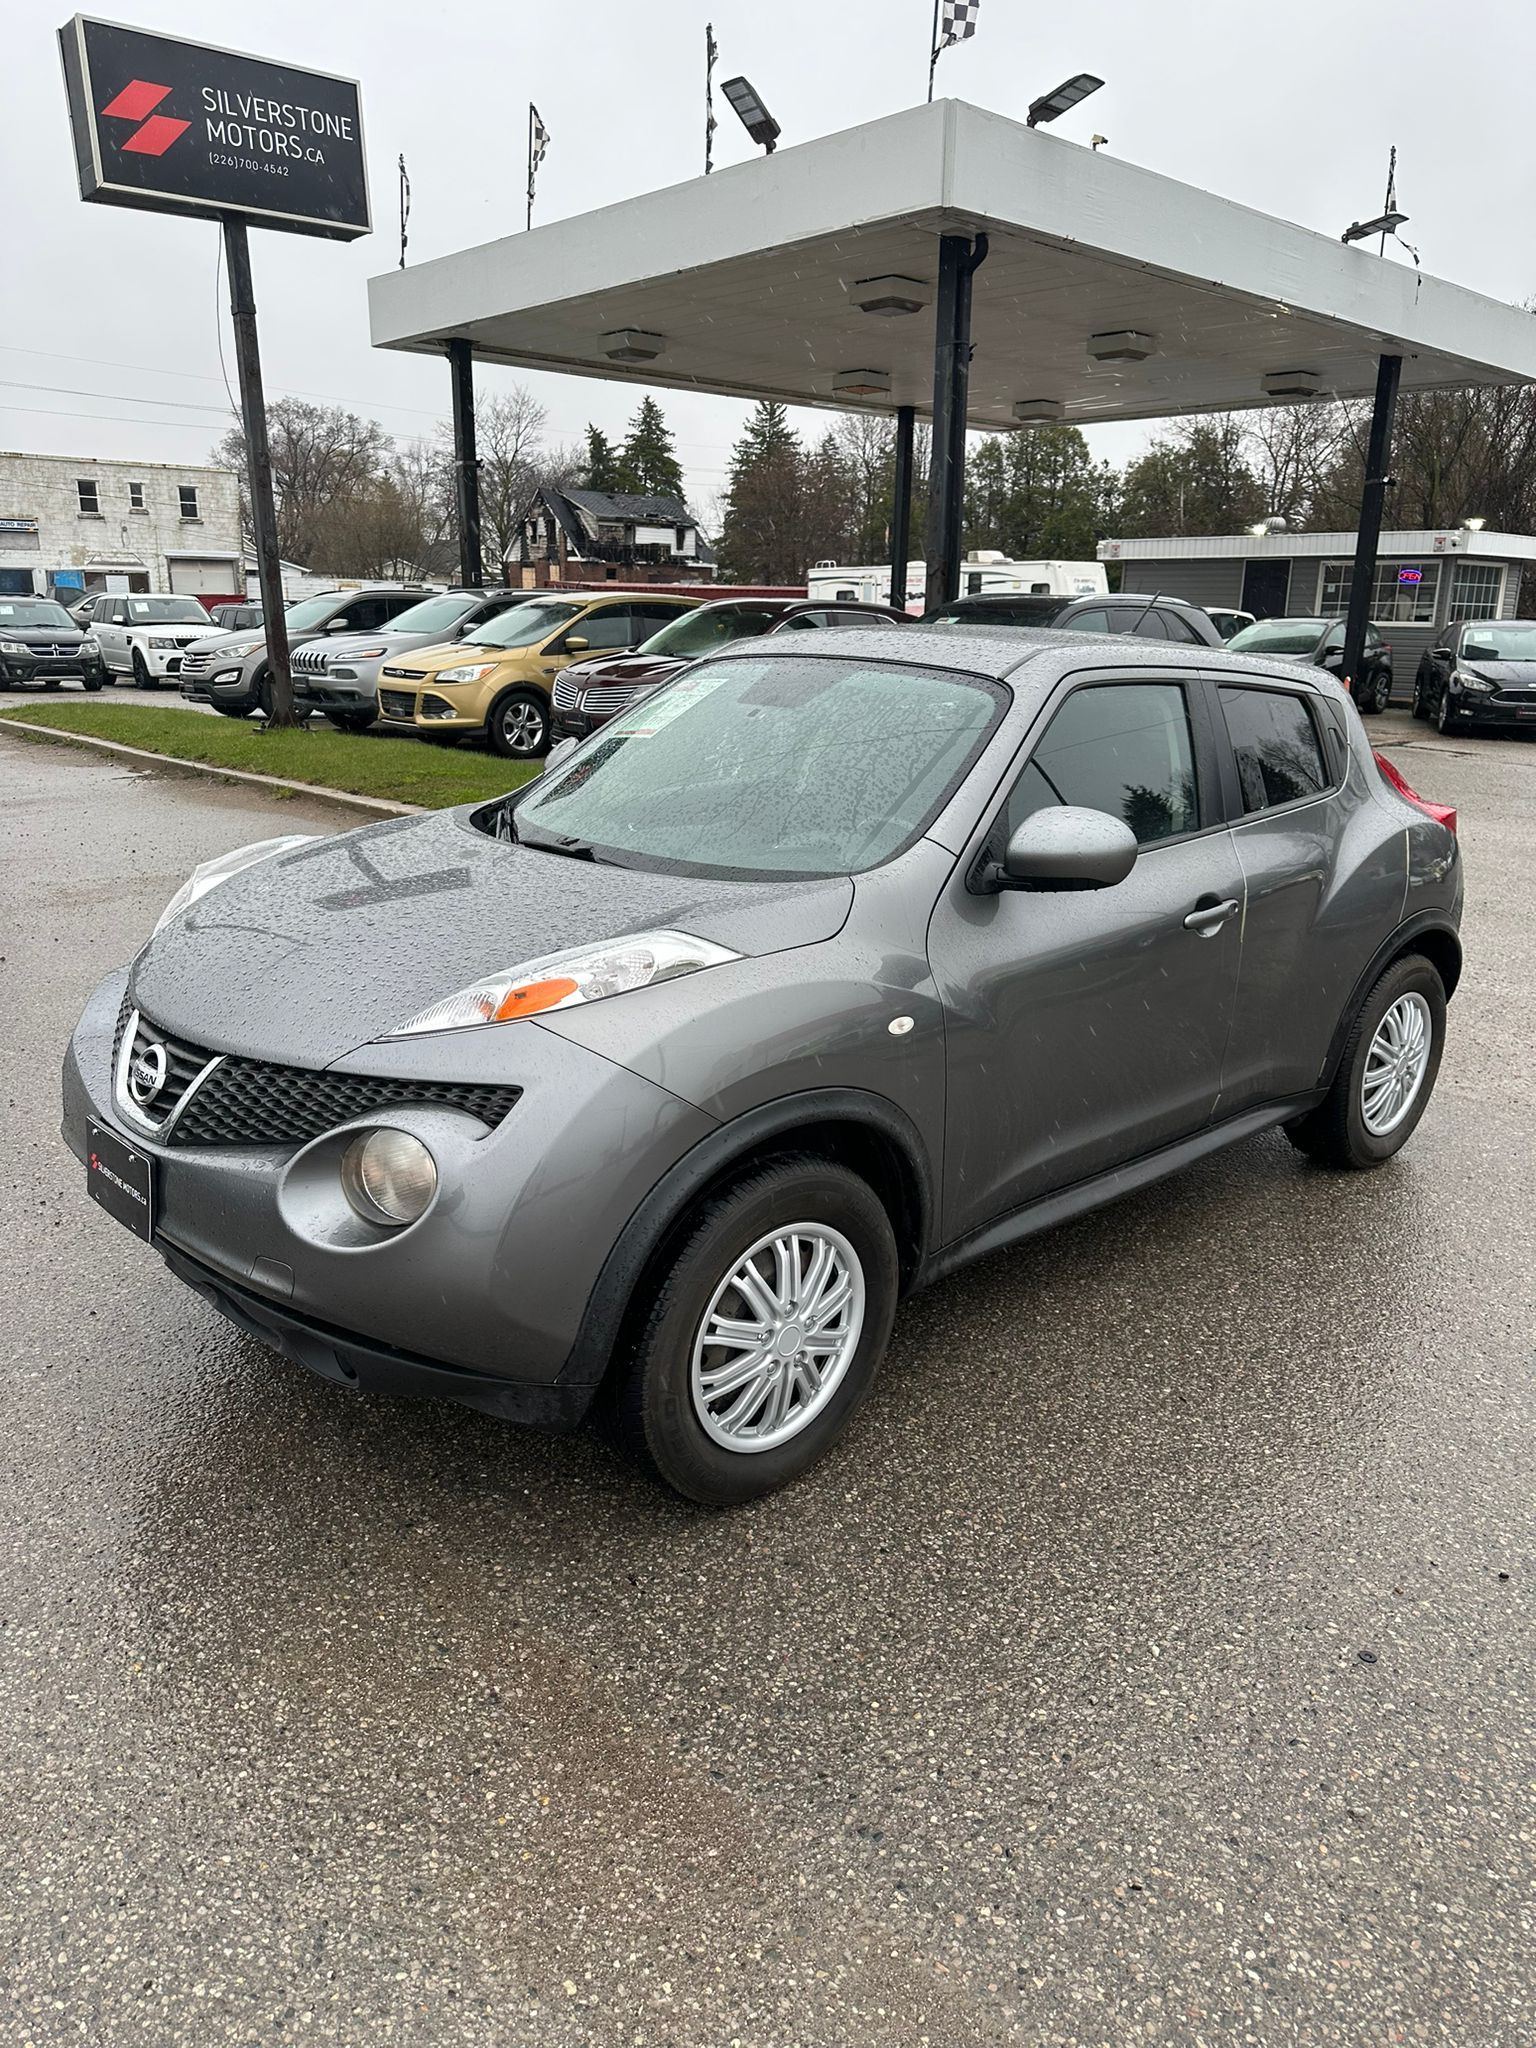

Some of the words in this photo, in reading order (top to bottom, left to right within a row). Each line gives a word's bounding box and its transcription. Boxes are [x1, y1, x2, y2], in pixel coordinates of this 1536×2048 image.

[201, 87, 354, 141] SILVERSTONE
[209, 152, 290, 177] (226)700-4542
[133, 1067, 158, 1086] SSAN
